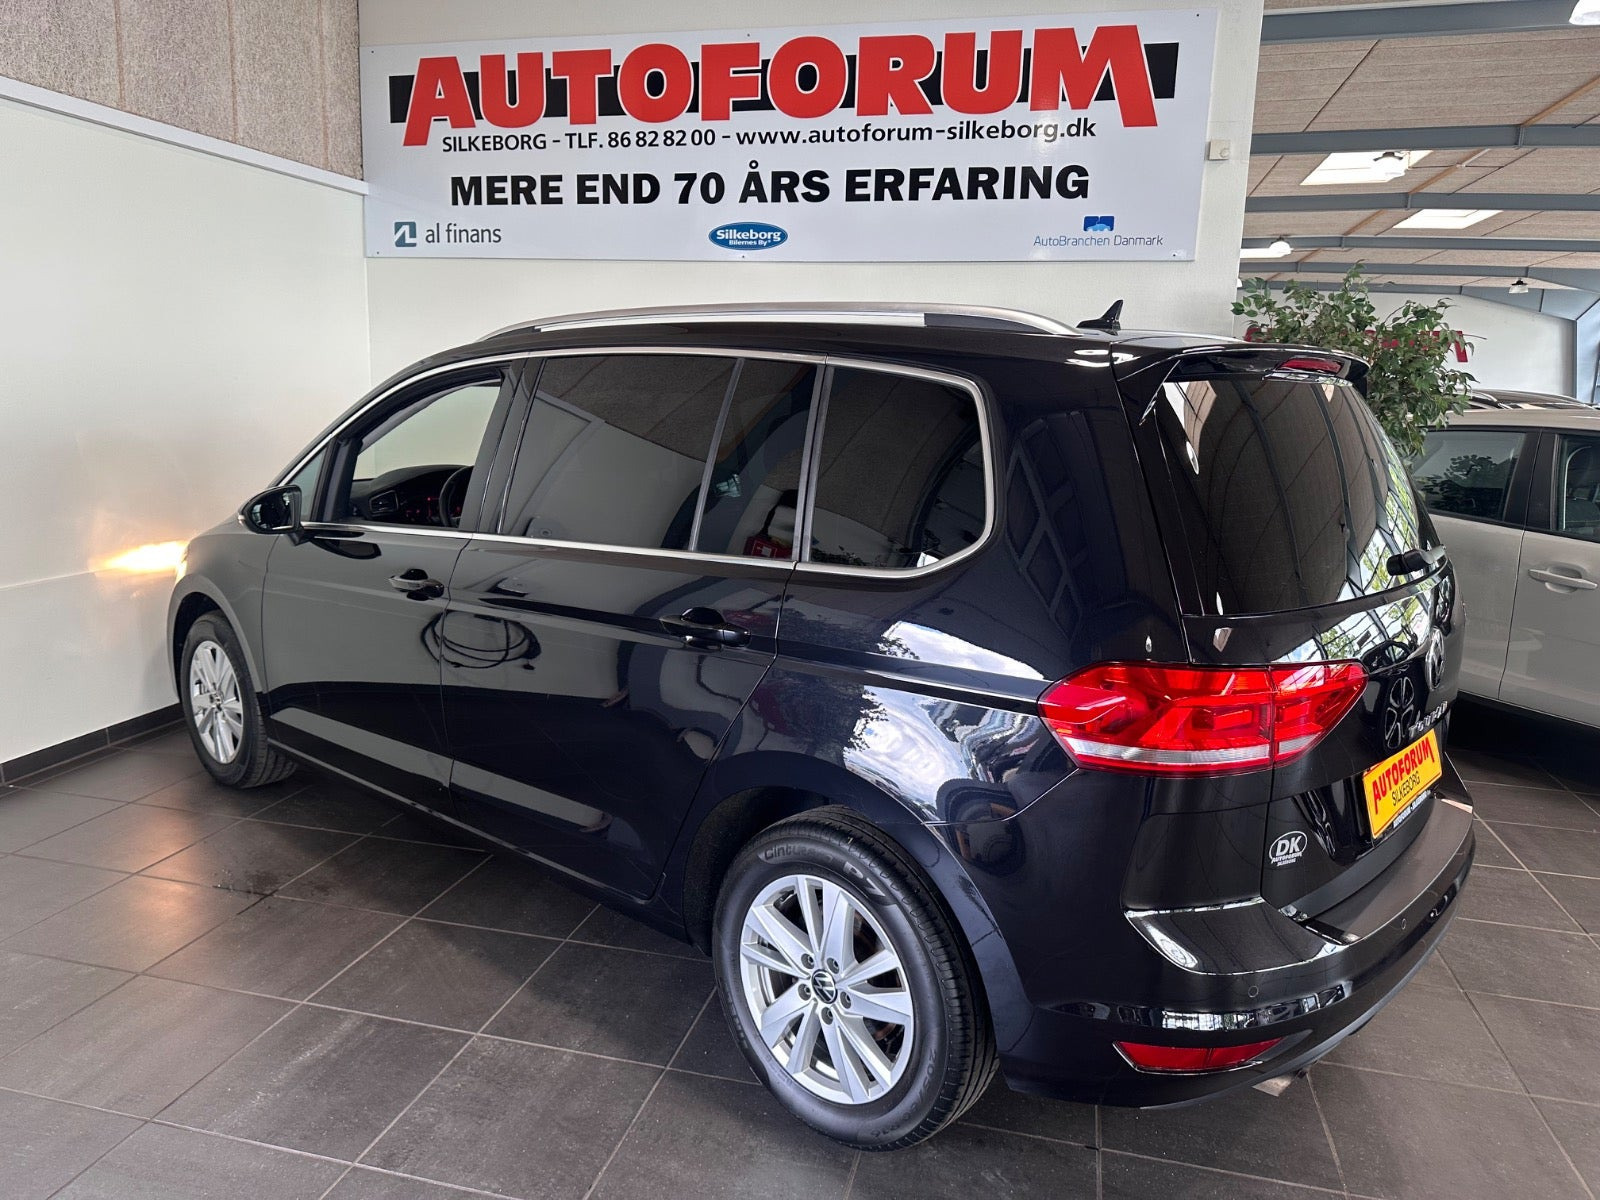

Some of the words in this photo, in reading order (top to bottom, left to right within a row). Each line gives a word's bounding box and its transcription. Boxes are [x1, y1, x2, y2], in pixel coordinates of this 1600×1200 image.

[403, 24, 1158, 146] AUTOFORUM
[442, 133, 547, 153] SILKEBORG
[564, 131, 604, 149] TLF.
[735, 117, 1097, 145] www.autoforum-silkeborg.dk
[451, 174, 564, 206] MERE
[576, 173, 661, 205] END
[673, 171, 725, 205] 70
[738, 159, 830, 204] ÅRS
[845, 164, 1089, 202] ERFARING
[425, 222, 441, 244] al
[445, 222, 502, 244] finans
[716, 229, 781, 242] Silkeborg
[1033, 234, 1110, 247] AutoBranchen
[1113, 234, 1164, 246] Danmark
[1372, 737, 1435, 815] AUTOFORUM
[1391, 770, 1421, 806] SILKEBORG
[1275, 835, 1303, 857] DK
